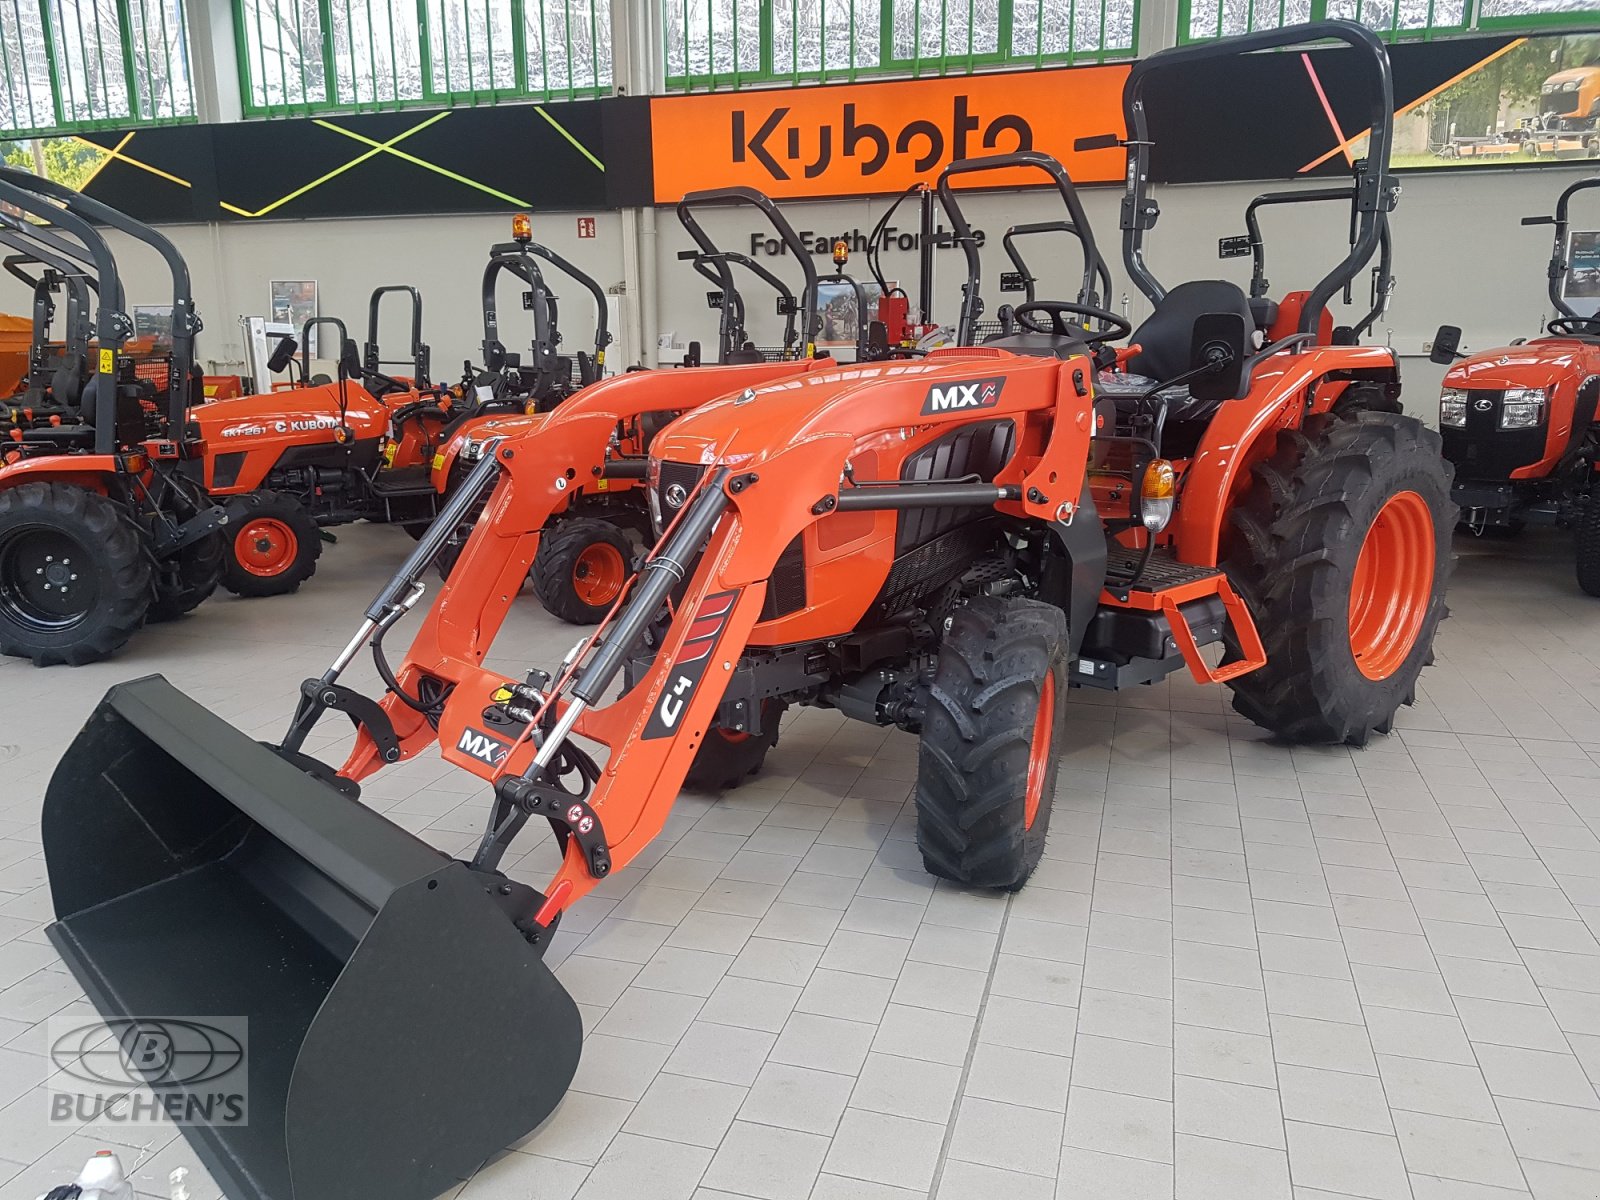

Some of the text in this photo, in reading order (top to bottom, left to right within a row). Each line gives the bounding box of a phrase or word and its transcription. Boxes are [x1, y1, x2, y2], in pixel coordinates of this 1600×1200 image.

[732, 95, 1033, 180] Kubota
[750, 232, 788, 256] For
[932, 383, 980, 411] MX
[290, 419, 340, 432] KUBOTA
[660, 675, 693, 728] C4
[459, 729, 500, 762] MX
